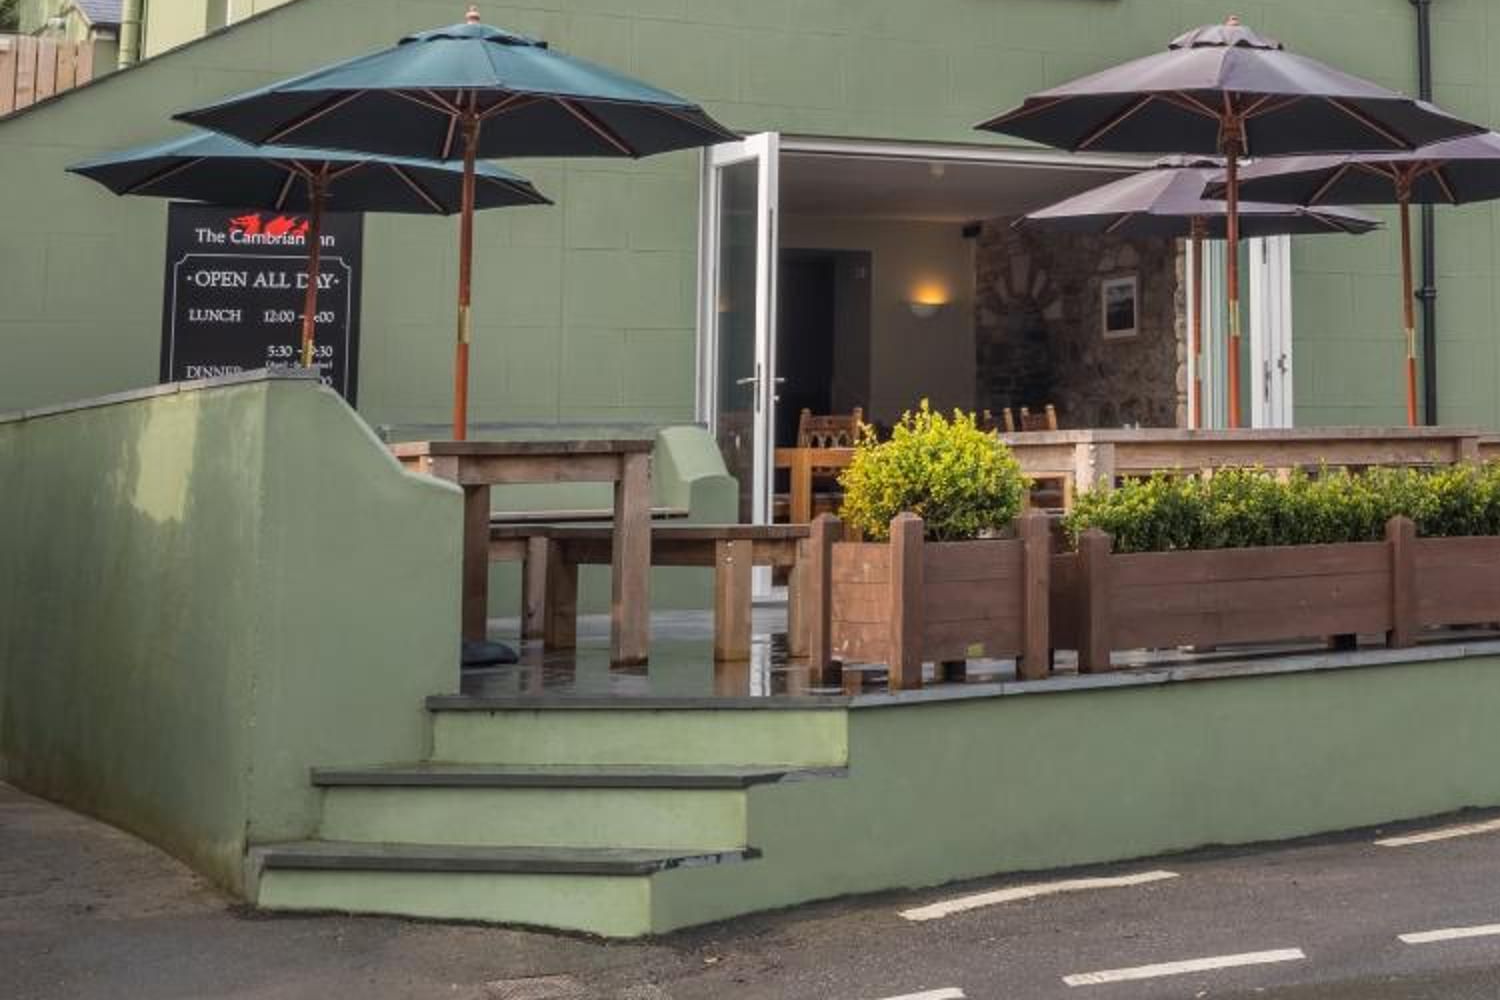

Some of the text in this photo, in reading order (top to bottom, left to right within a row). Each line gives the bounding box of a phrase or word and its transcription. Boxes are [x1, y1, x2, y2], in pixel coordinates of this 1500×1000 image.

[196, 229, 335, 247] The Cambrian nn
[195, 271, 247, 287] OPEN
[253, 272, 291, 288] ALL
[189, 309, 242, 322] LUNCH
[264, 310, 295, 323] 12:00
[267, 345, 293, 357] 5:30
